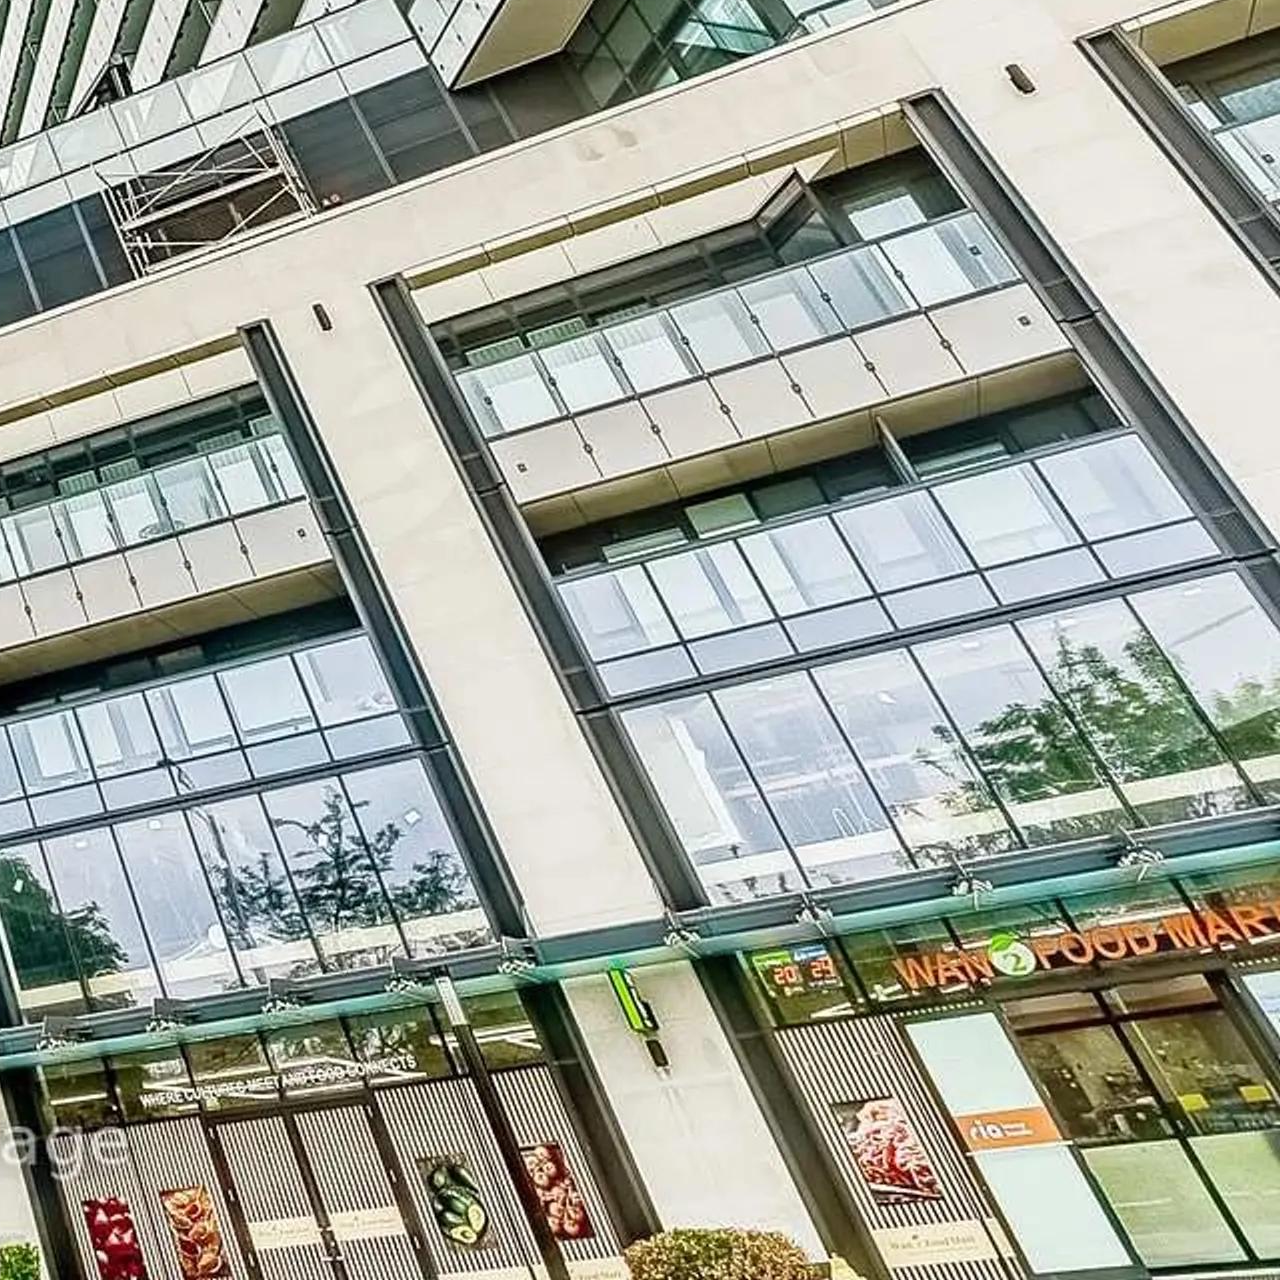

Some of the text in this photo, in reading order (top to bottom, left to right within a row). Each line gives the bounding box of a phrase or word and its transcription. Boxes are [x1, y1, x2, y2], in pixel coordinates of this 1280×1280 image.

[892, 946, 995, 989] WAN
[1031, 922, 1158, 970] FOOD
[140, 1090, 184, 1110] WHERE
[184, 1079, 247, 1101] CULTURES
[247, 1074, 282, 1093] MEET
[347, 1054, 417, 1077] CONNECTS
